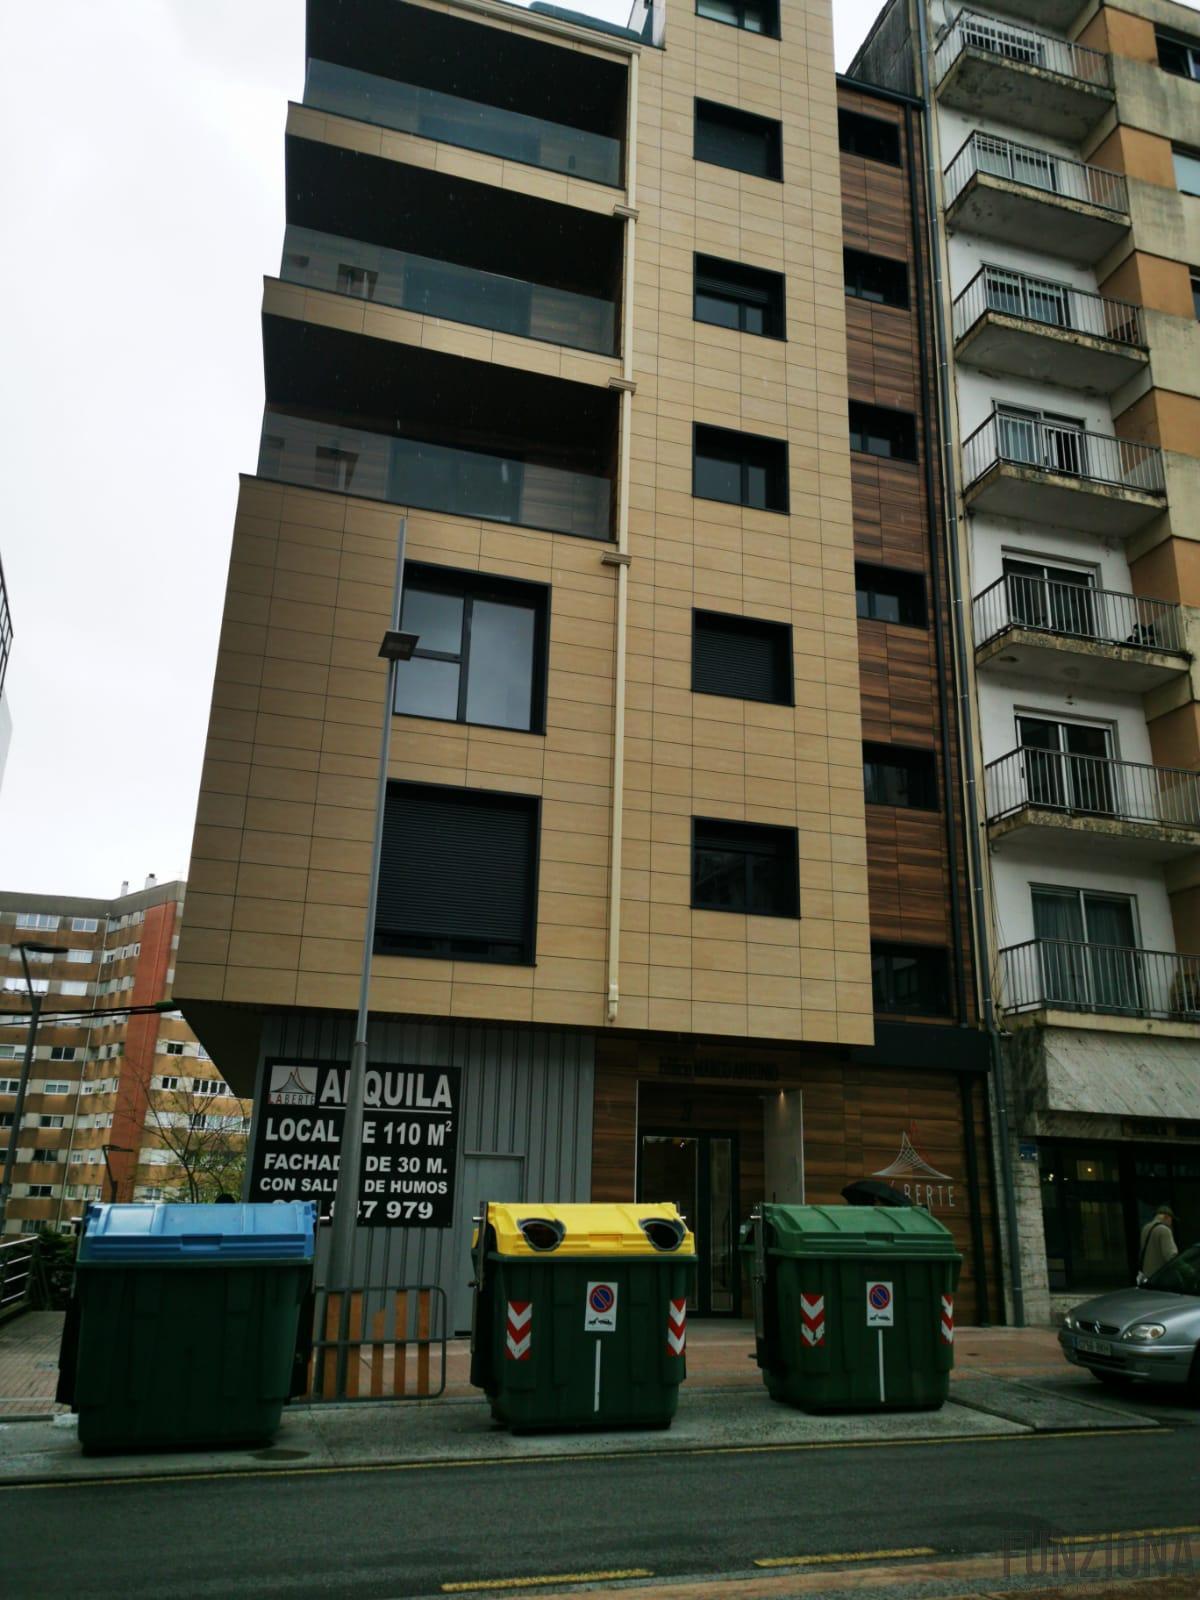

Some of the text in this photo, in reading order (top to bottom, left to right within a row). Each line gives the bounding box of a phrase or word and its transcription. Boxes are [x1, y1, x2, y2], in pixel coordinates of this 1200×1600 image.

[265, 1117, 340, 1142] LOCAL
[362, 1121, 376, 1144] E
[383, 1121, 421, 1145] 110
[264, 1153, 448, 1174] FACHAD DE 30 M.
[260, 1177, 448, 1195] CON SALI DE HUMOS
[889, 1182, 956, 1207] BERTE
[386, 1201, 433, 1219] 979
